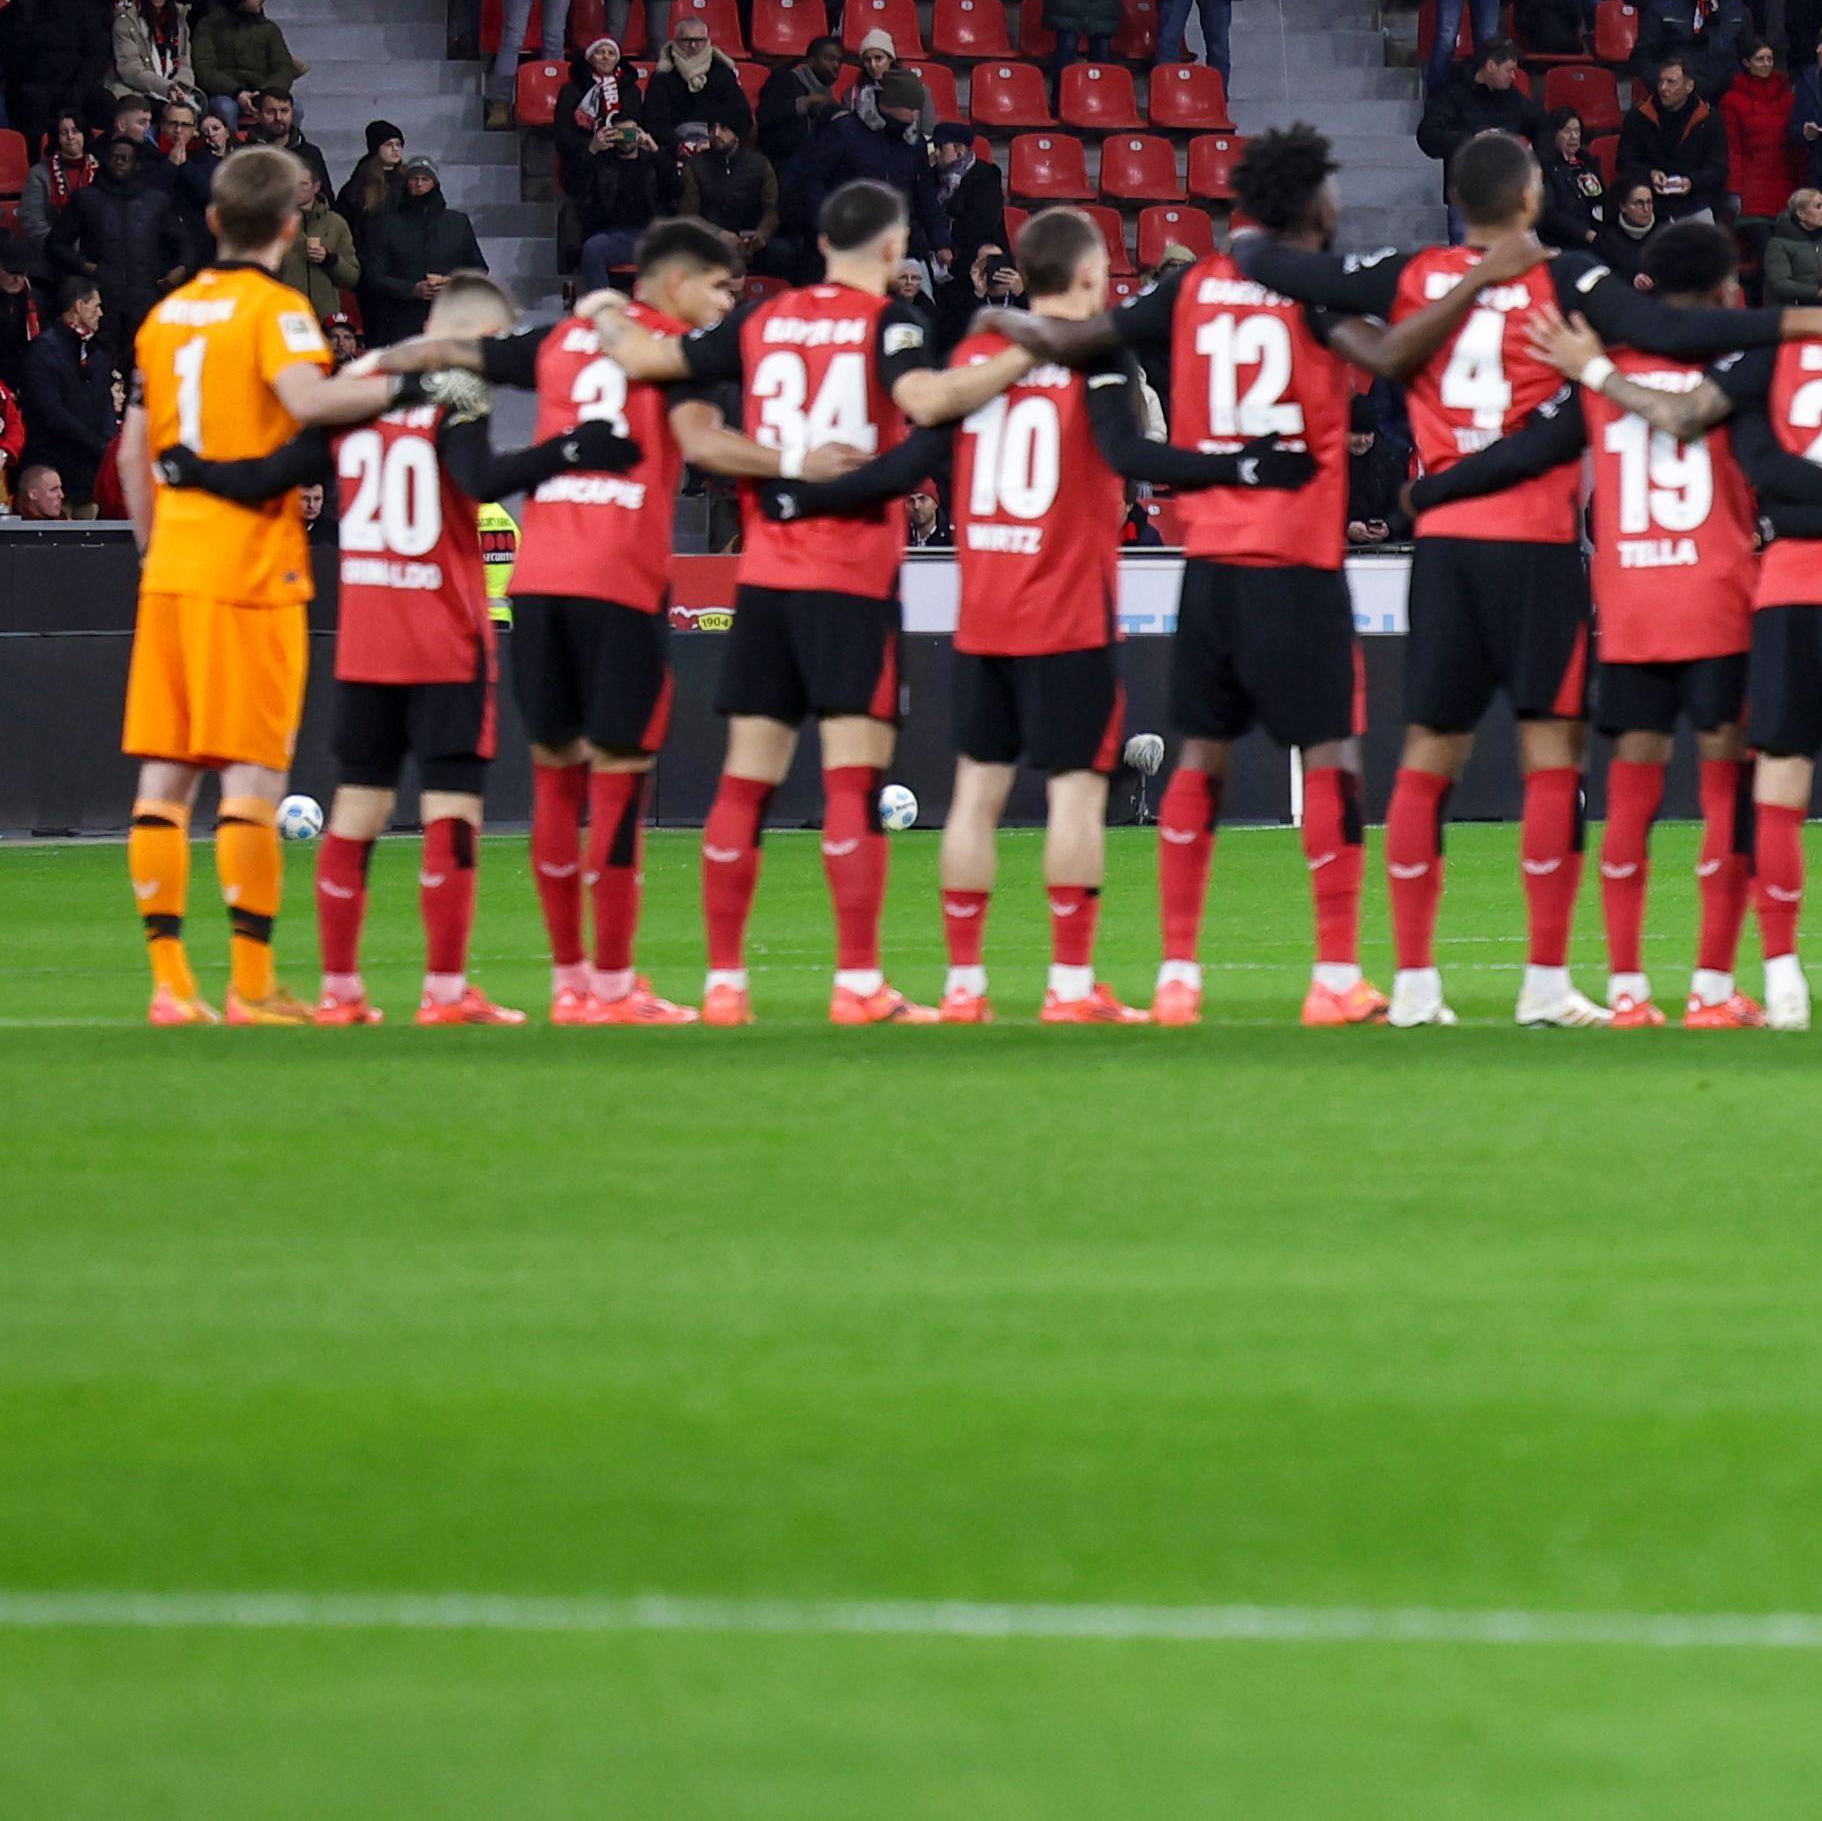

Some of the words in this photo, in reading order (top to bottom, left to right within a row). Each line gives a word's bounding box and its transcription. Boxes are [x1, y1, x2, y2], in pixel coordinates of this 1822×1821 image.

[173, 334, 207, 456] 1
[570, 357, 631, 439] 3
[752, 350, 879, 458] 34
[1195, 312, 1305, 437] 12
[1440, 307, 1513, 430] 4
[337, 428, 443, 557] 20
[962, 393, 1061, 520] 10
[1604, 410, 1714, 534] 19
[1616, 537, 1700, 569] TELLA
[701, 616, 730, 629] 1904
